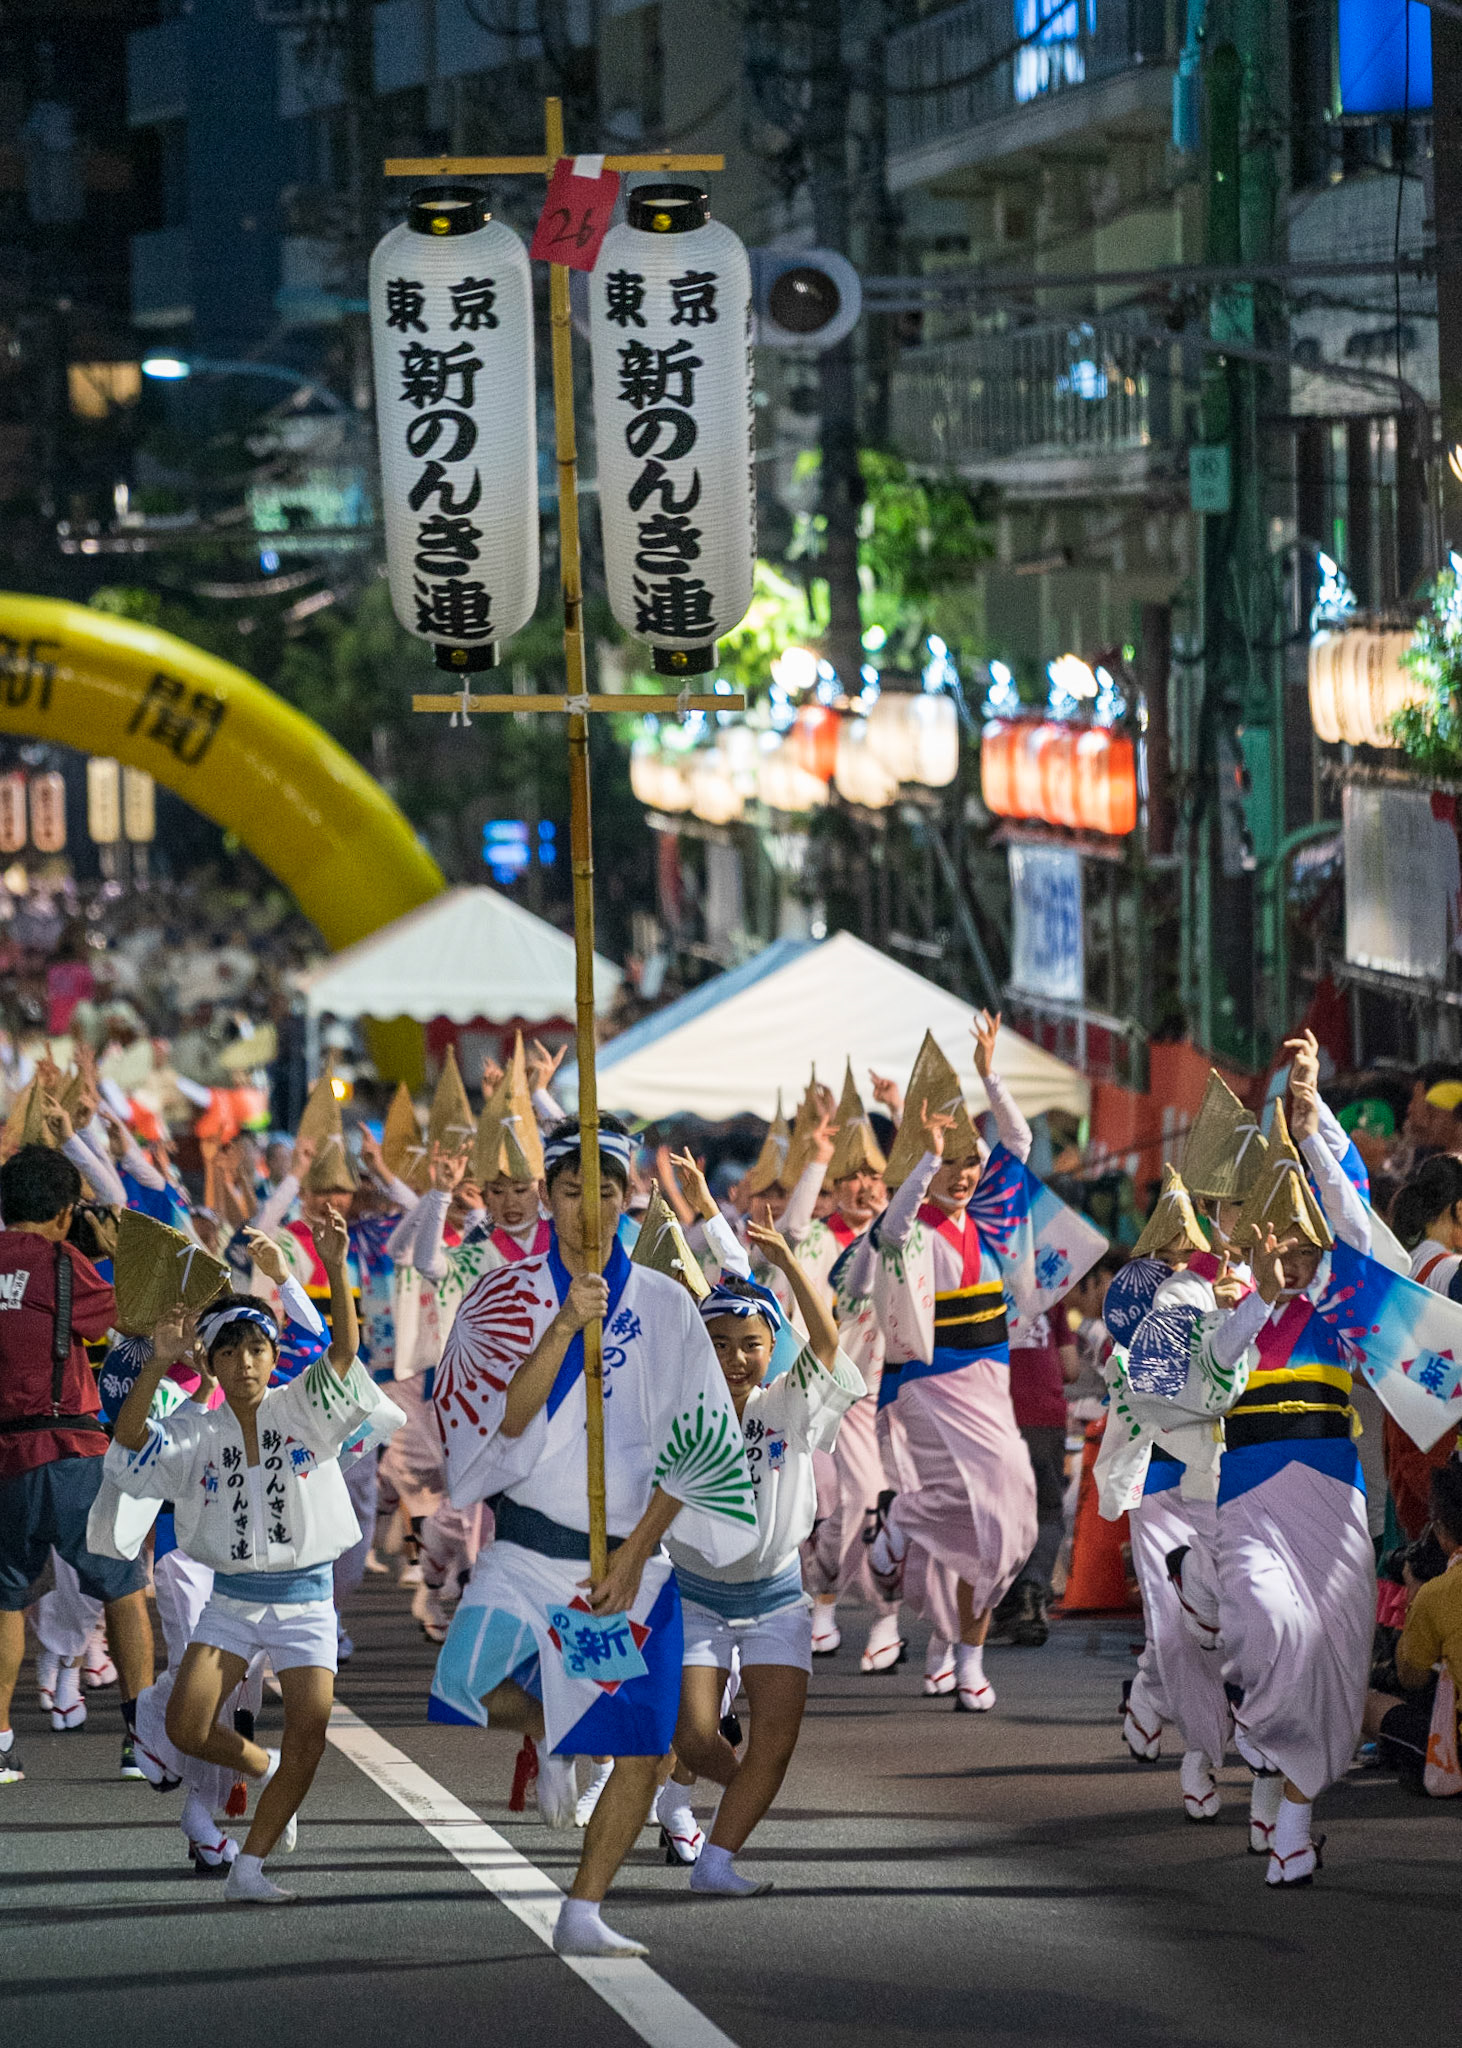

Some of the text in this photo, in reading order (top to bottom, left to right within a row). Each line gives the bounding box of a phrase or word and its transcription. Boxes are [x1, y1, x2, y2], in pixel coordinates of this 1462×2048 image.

[548, 208, 595, 249] 26
[385, 277, 499, 334] 東京
[604, 269, 719, 329] 東京
[398, 340, 496, 640] 新のんき連
[616, 338, 720, 639] 新のんき連
[221, 1445, 253, 1560] 新のんき連
[262, 1429, 292, 1544] 新のんき連
